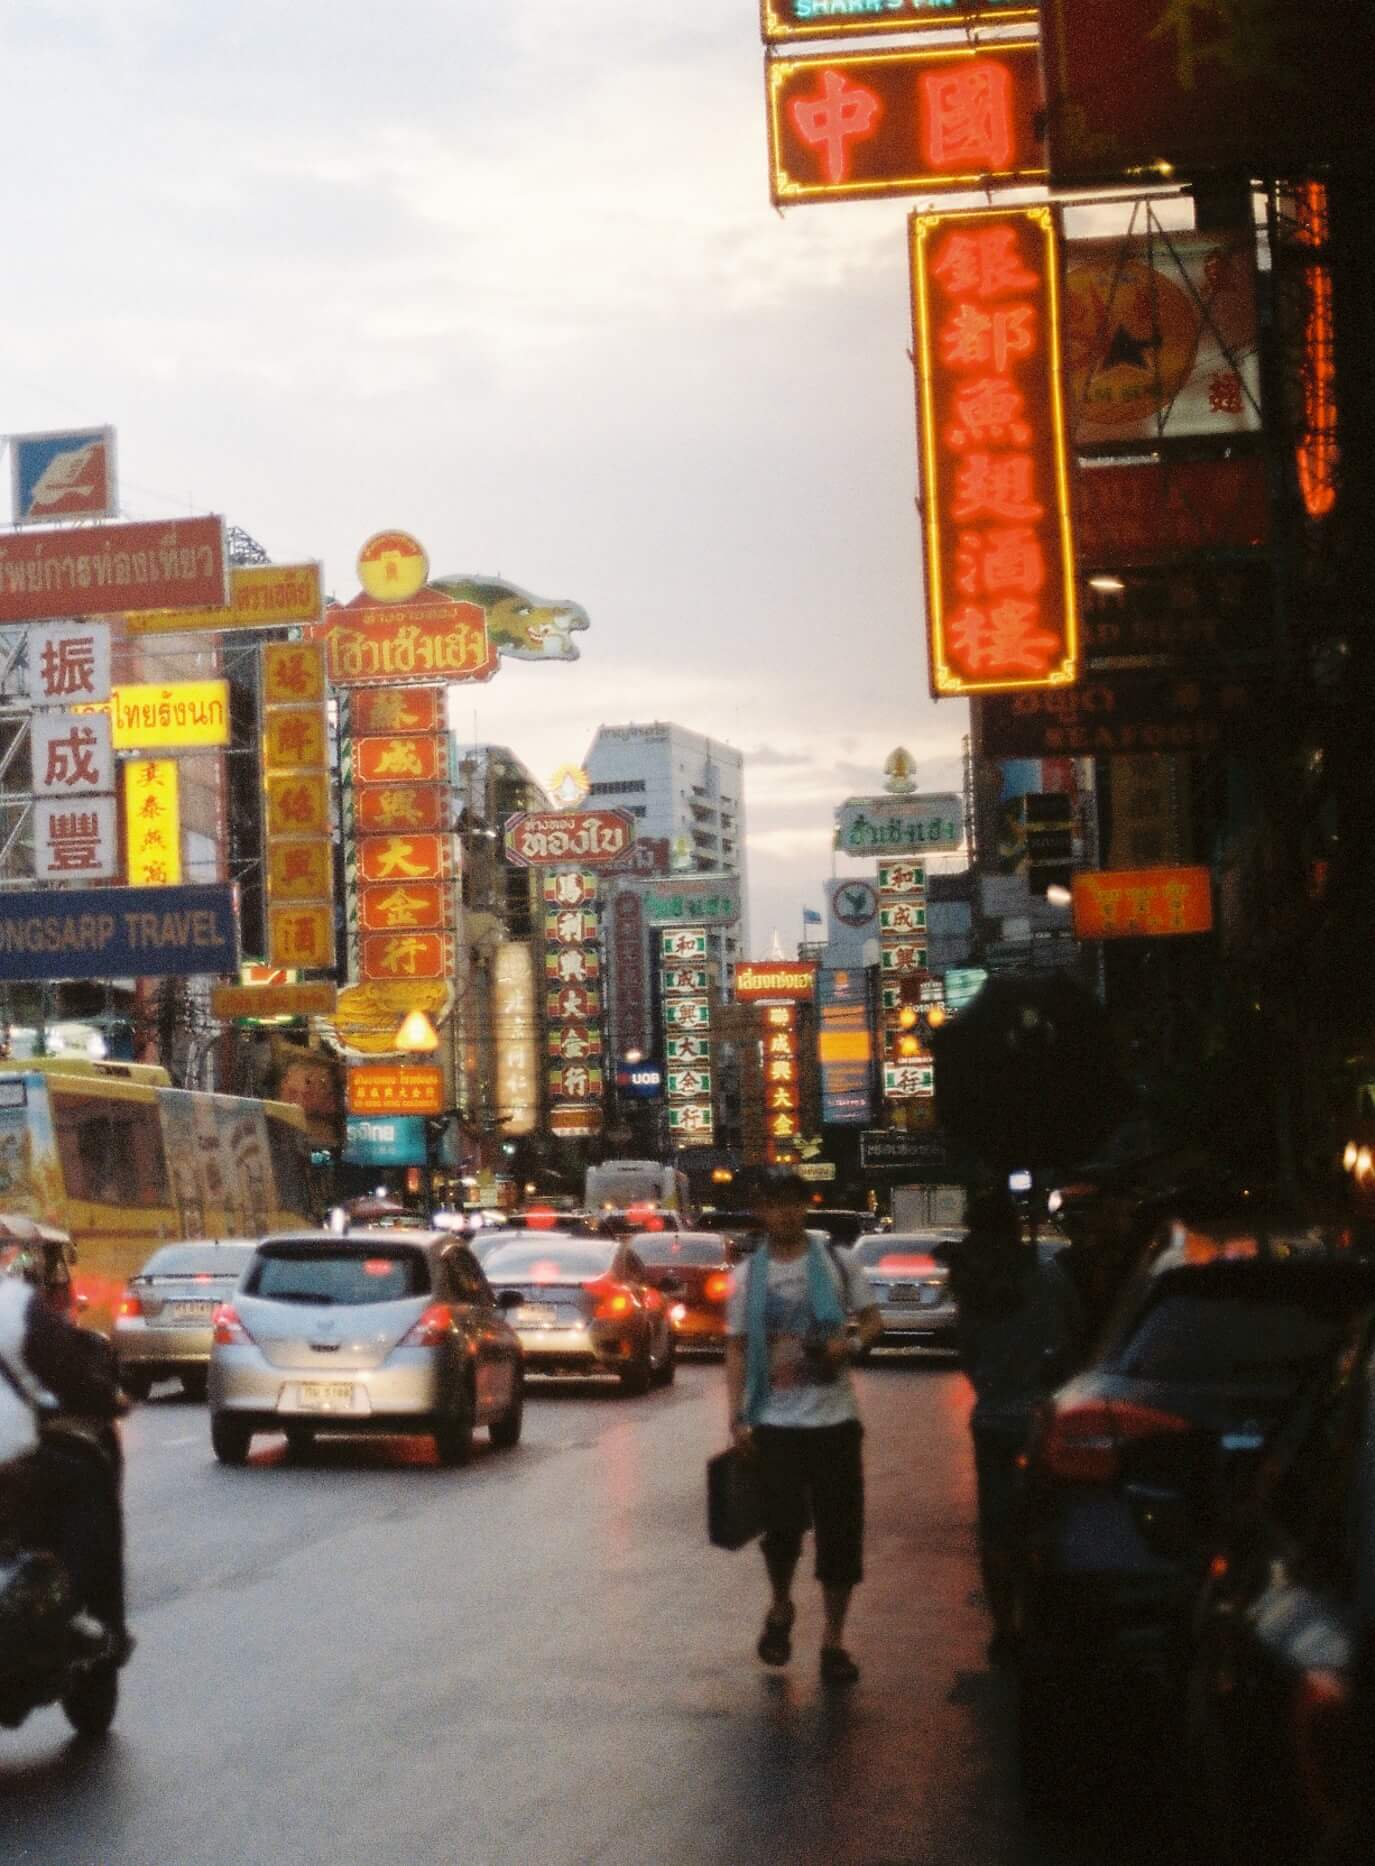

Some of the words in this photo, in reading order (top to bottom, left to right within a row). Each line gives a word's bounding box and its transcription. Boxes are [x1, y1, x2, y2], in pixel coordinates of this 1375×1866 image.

[790, 60, 1014, 184] 中國
[40, 637, 103, 871] 振成豐
[520, 818, 623, 857] ทองใบ
[126, 909, 225, 947] TRAVEL
[890, 865, 921, 1091] 和成興行
[631, 1072, 660, 1085] UOB
[768, 1006, 794, 1160] 聯成興大金
